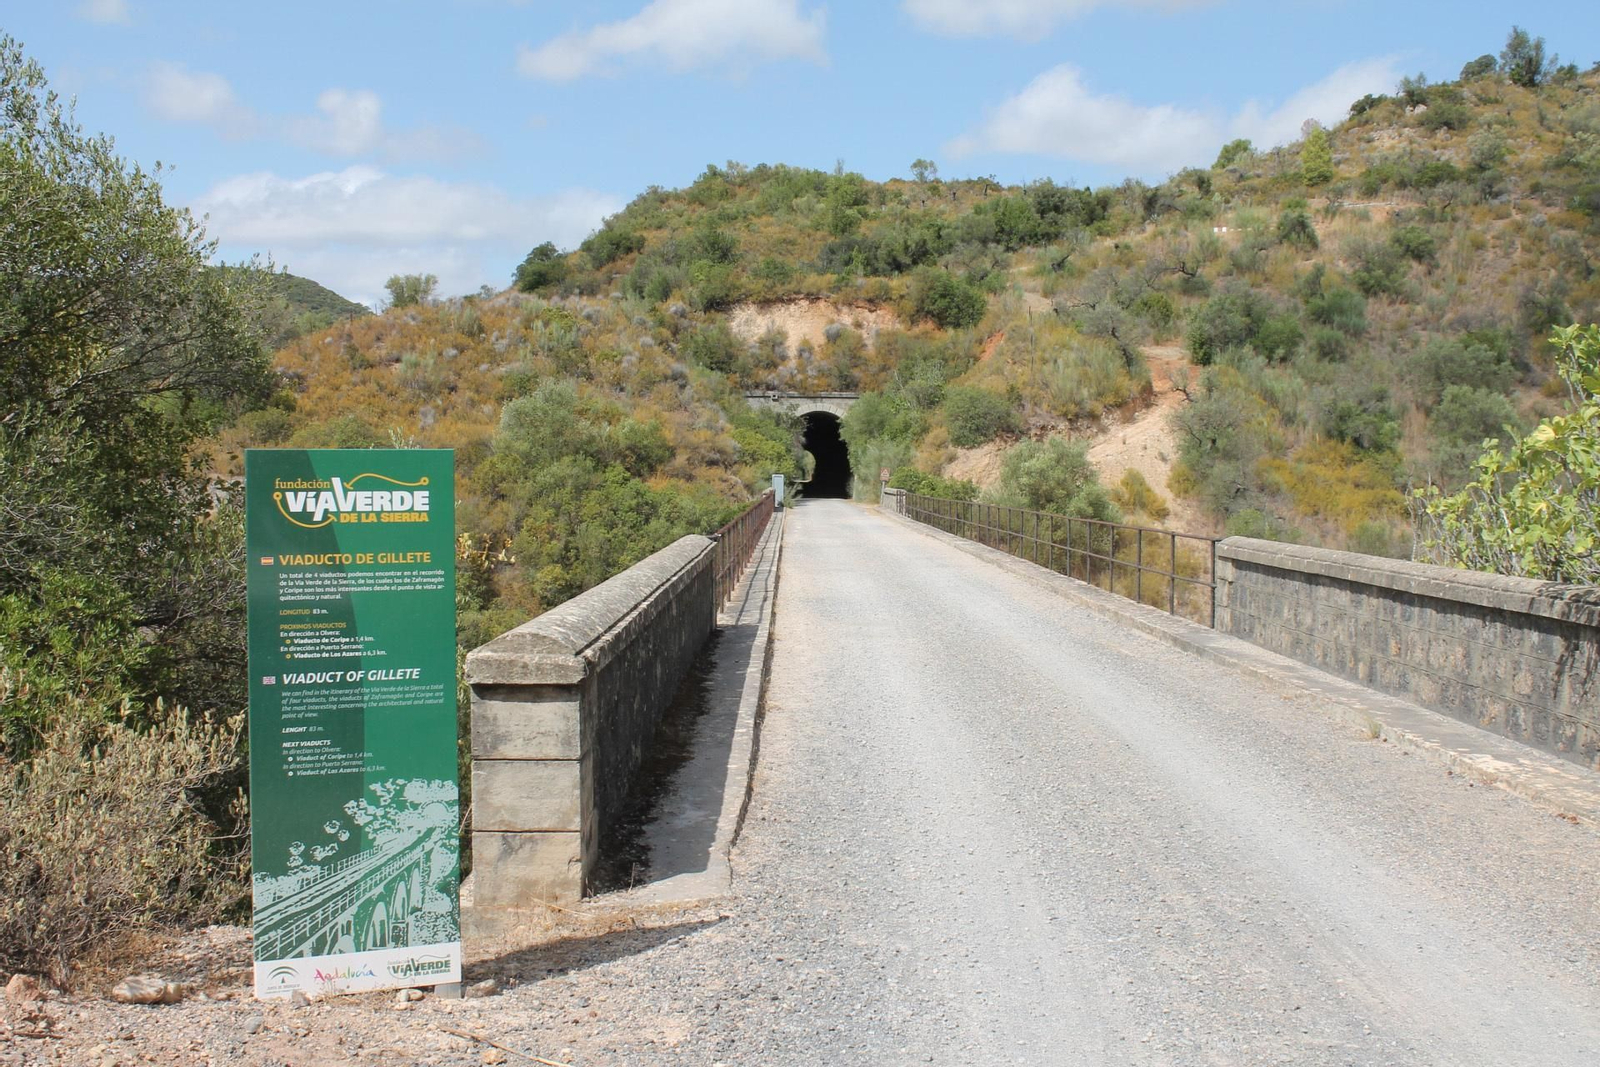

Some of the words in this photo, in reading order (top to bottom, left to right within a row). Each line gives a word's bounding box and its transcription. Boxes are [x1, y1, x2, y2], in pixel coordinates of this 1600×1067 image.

[275, 478, 330, 489] fundación
[340, 513, 358, 523] DE
[361, 513, 378, 522] LA
[380, 512, 429, 522] SIERRA
[279, 554, 352, 565] VIADUCTO
[356, 553, 374, 564] DE
[378, 552, 431, 564] GILLETE
[282, 672, 344, 684] VIADUCT
[346, 671, 366, 682] OF
[368, 668, 421, 680] GILLETE
[314, 963, 377, 982] Andalucía
